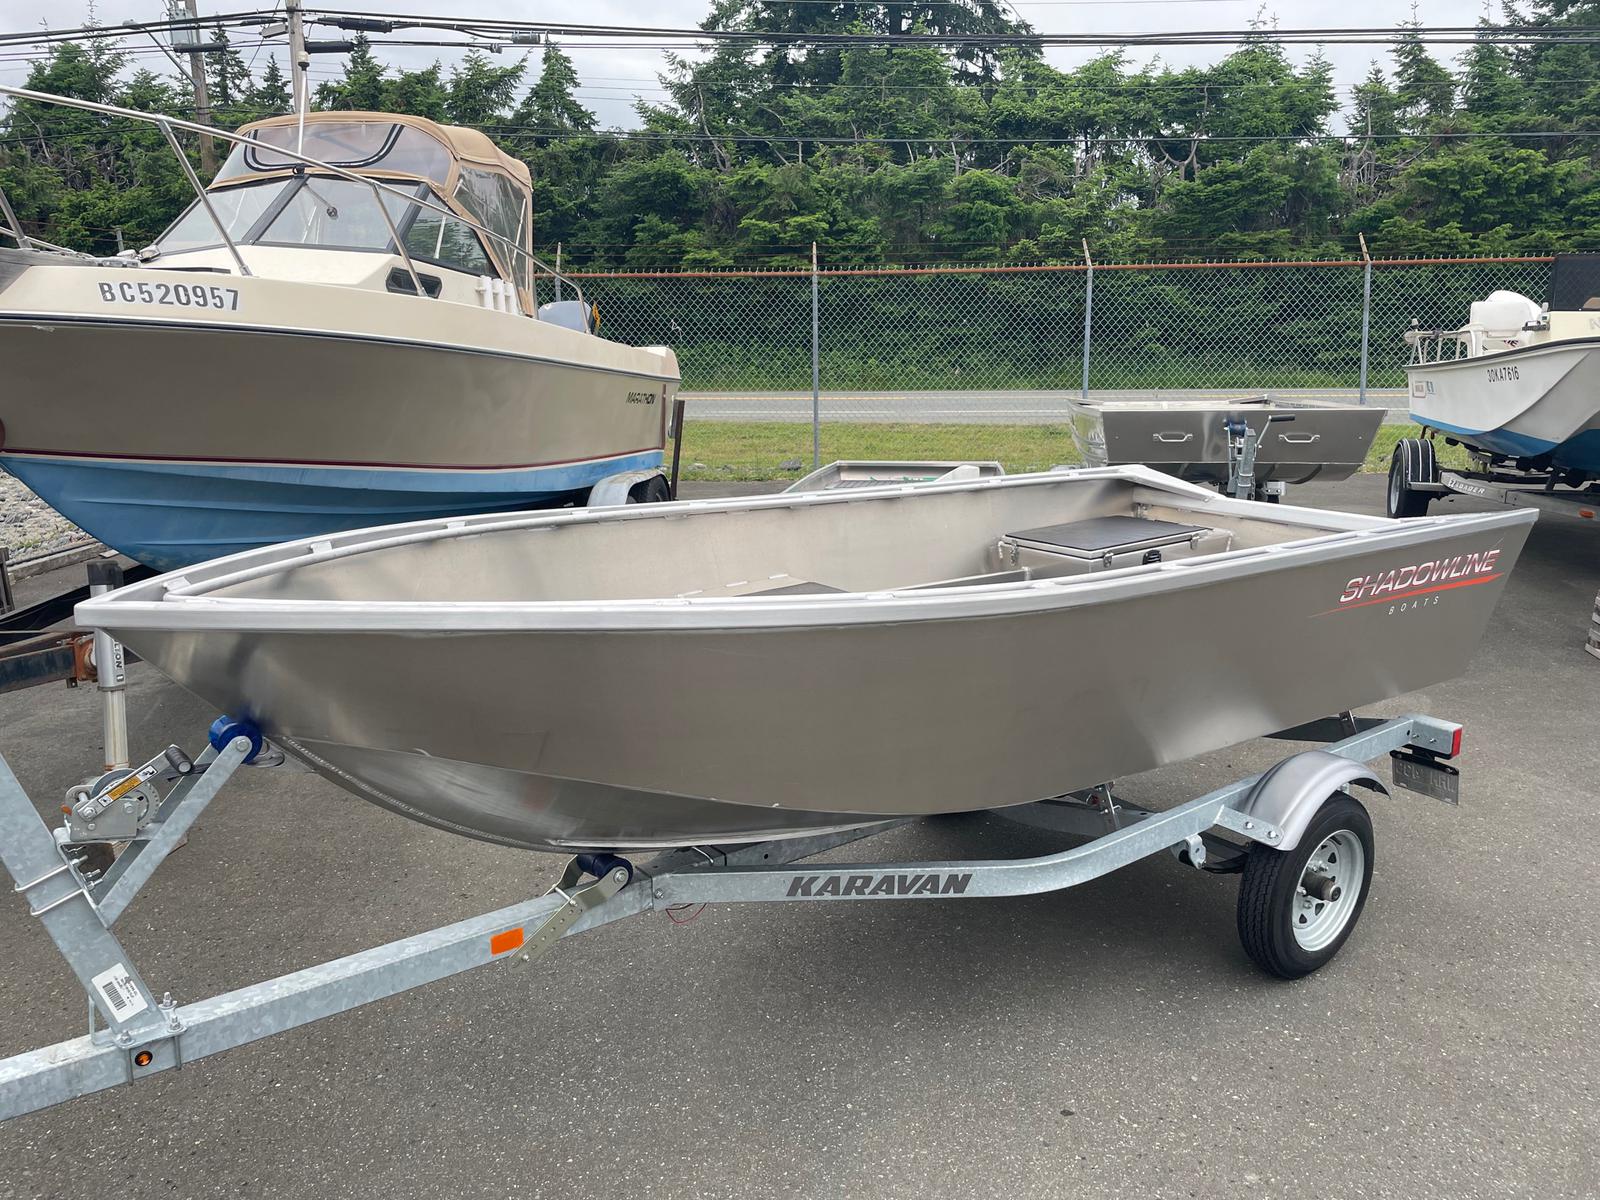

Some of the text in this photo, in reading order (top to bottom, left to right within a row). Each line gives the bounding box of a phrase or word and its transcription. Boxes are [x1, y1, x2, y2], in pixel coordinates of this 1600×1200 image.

[98, 282, 239, 311] BC520957
[1339, 549, 1501, 603] SHADOWLINE
[1388, 596, 1440, 615] BOATS
[786, 873, 973, 897] KARAVAN
